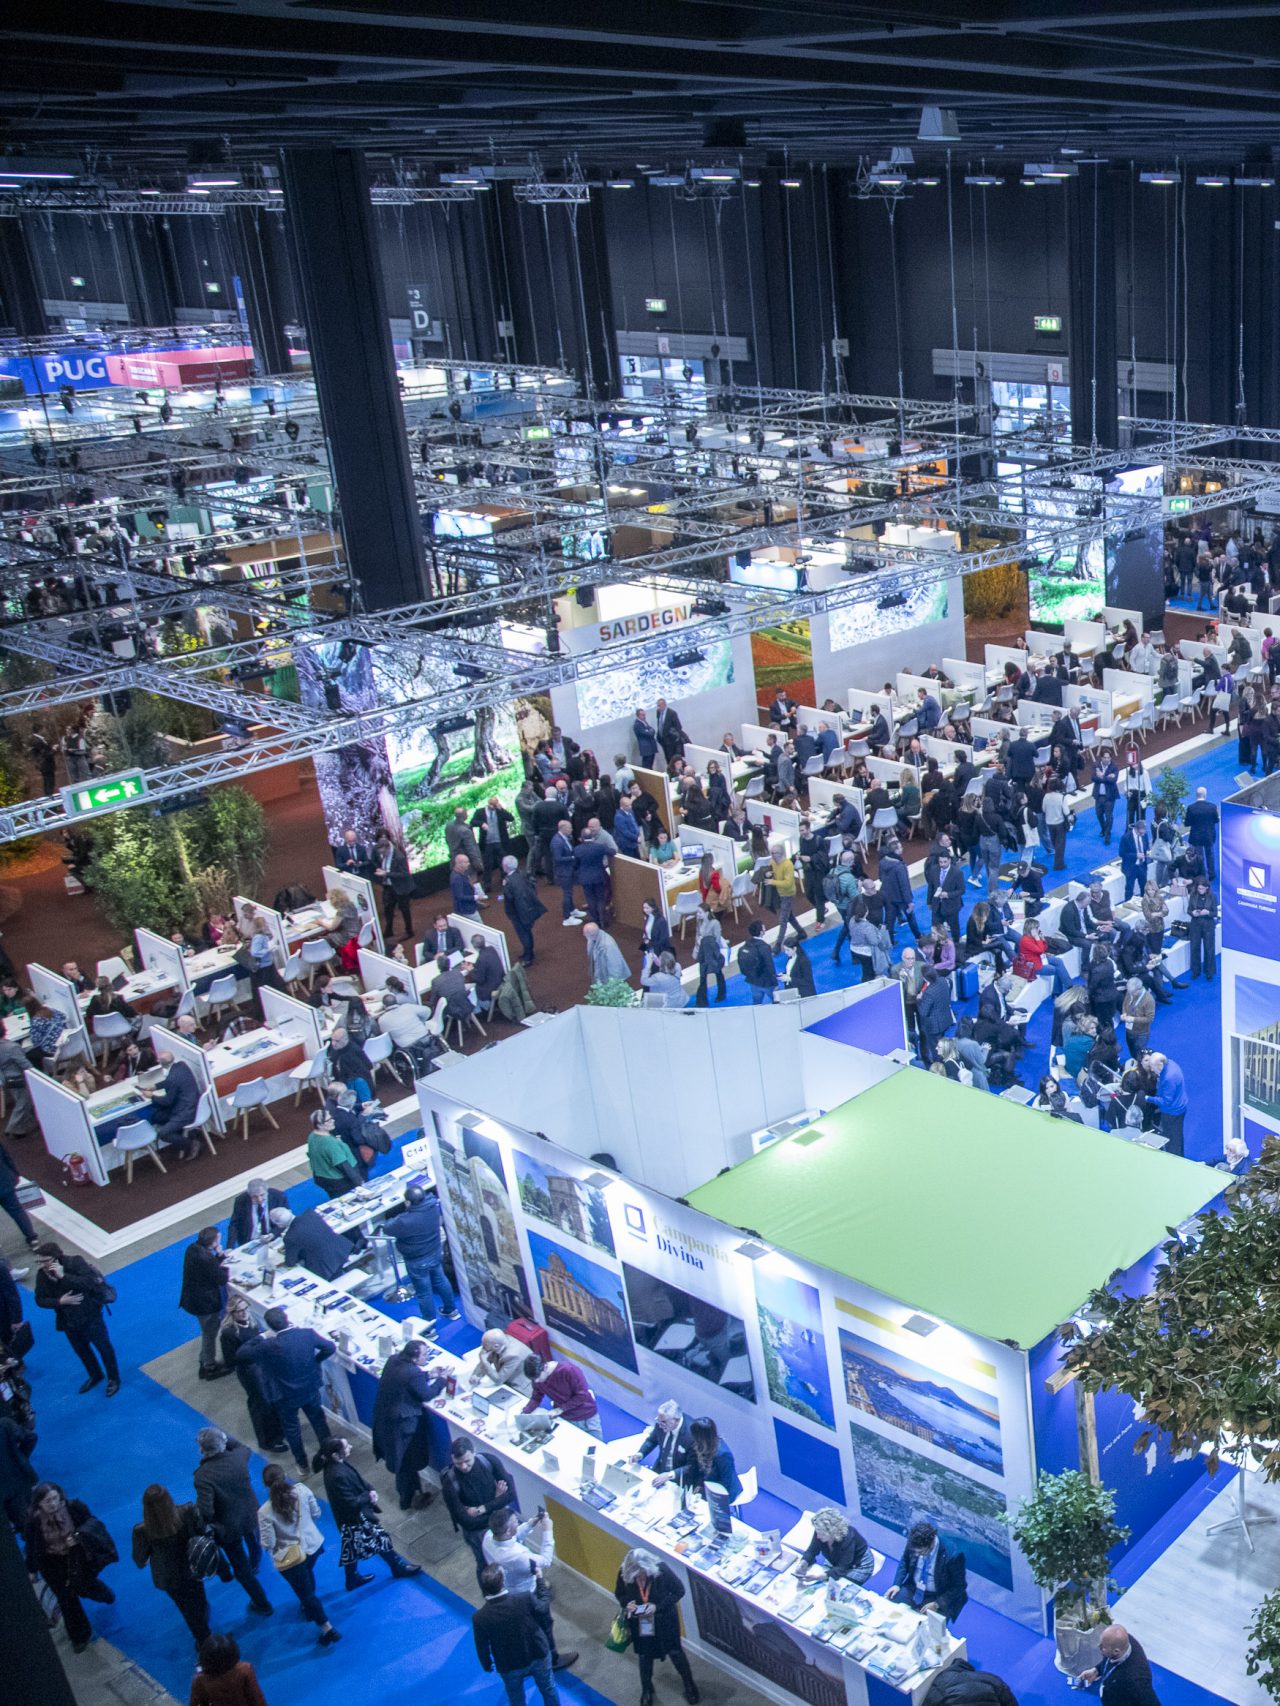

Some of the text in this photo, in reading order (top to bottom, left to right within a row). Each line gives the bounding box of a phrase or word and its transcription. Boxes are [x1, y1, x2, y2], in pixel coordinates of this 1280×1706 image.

[413, 310, 429, 329] D
[1051, 369, 1060, 381] 9
[652, 1215, 735, 1266] Campania.
[656, 1234, 705, 1271] Divina
